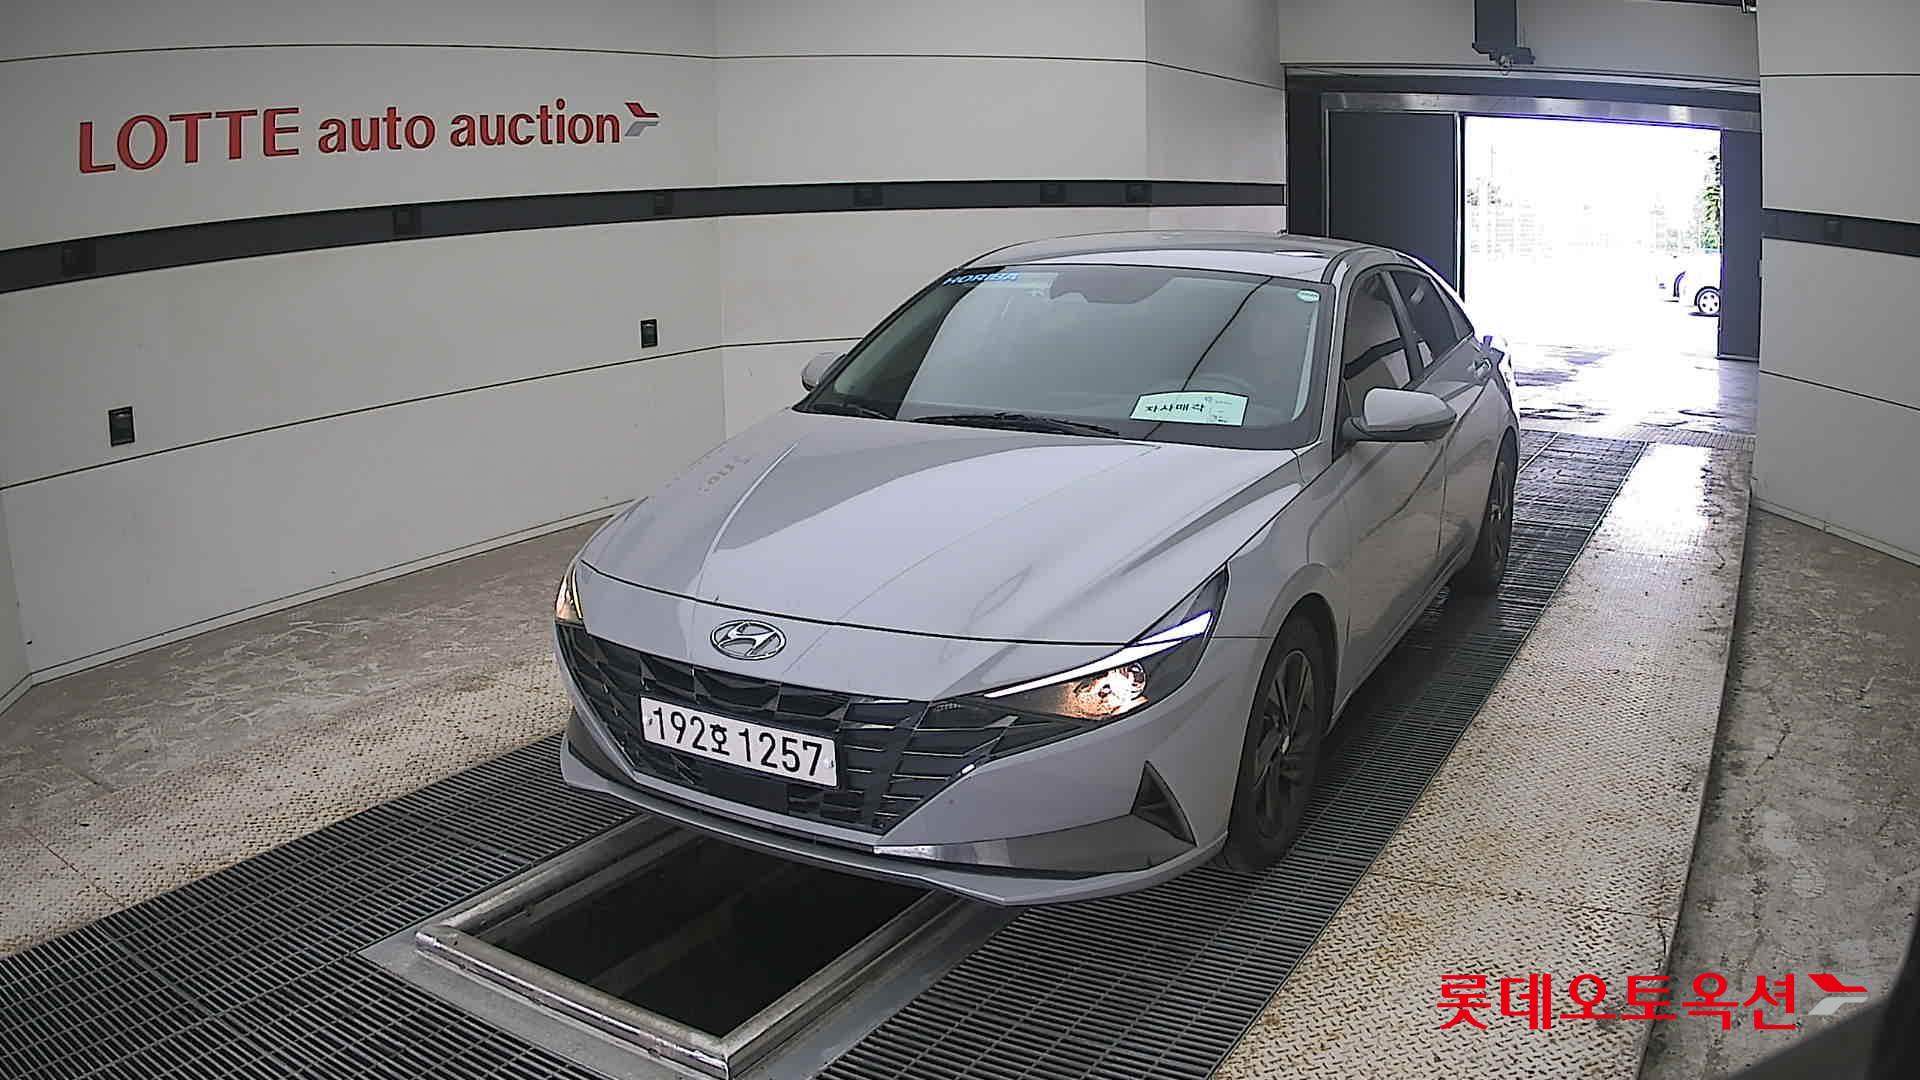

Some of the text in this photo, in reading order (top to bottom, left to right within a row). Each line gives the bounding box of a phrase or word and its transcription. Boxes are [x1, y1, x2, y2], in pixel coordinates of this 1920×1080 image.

[79, 98, 622, 173] LOTTE auto auction
[653, 707, 823, 777] 192호 1257
